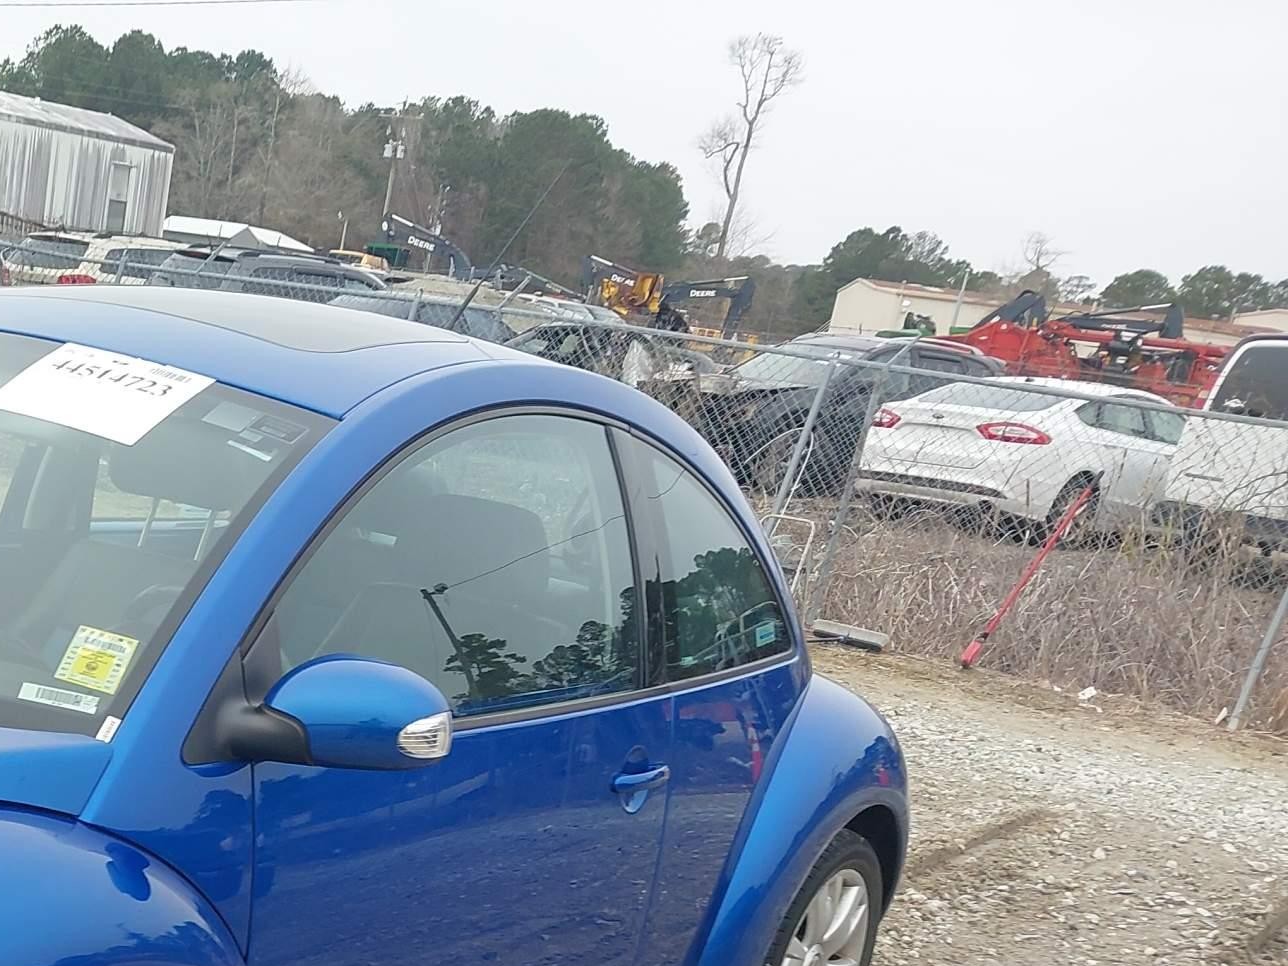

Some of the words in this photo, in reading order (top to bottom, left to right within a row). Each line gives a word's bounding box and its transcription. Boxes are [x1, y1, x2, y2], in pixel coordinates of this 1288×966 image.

[407, 236, 436, 252] DEERE
[689, 289, 717, 298] DEERE
[52, 359, 173, 397] 44514723
